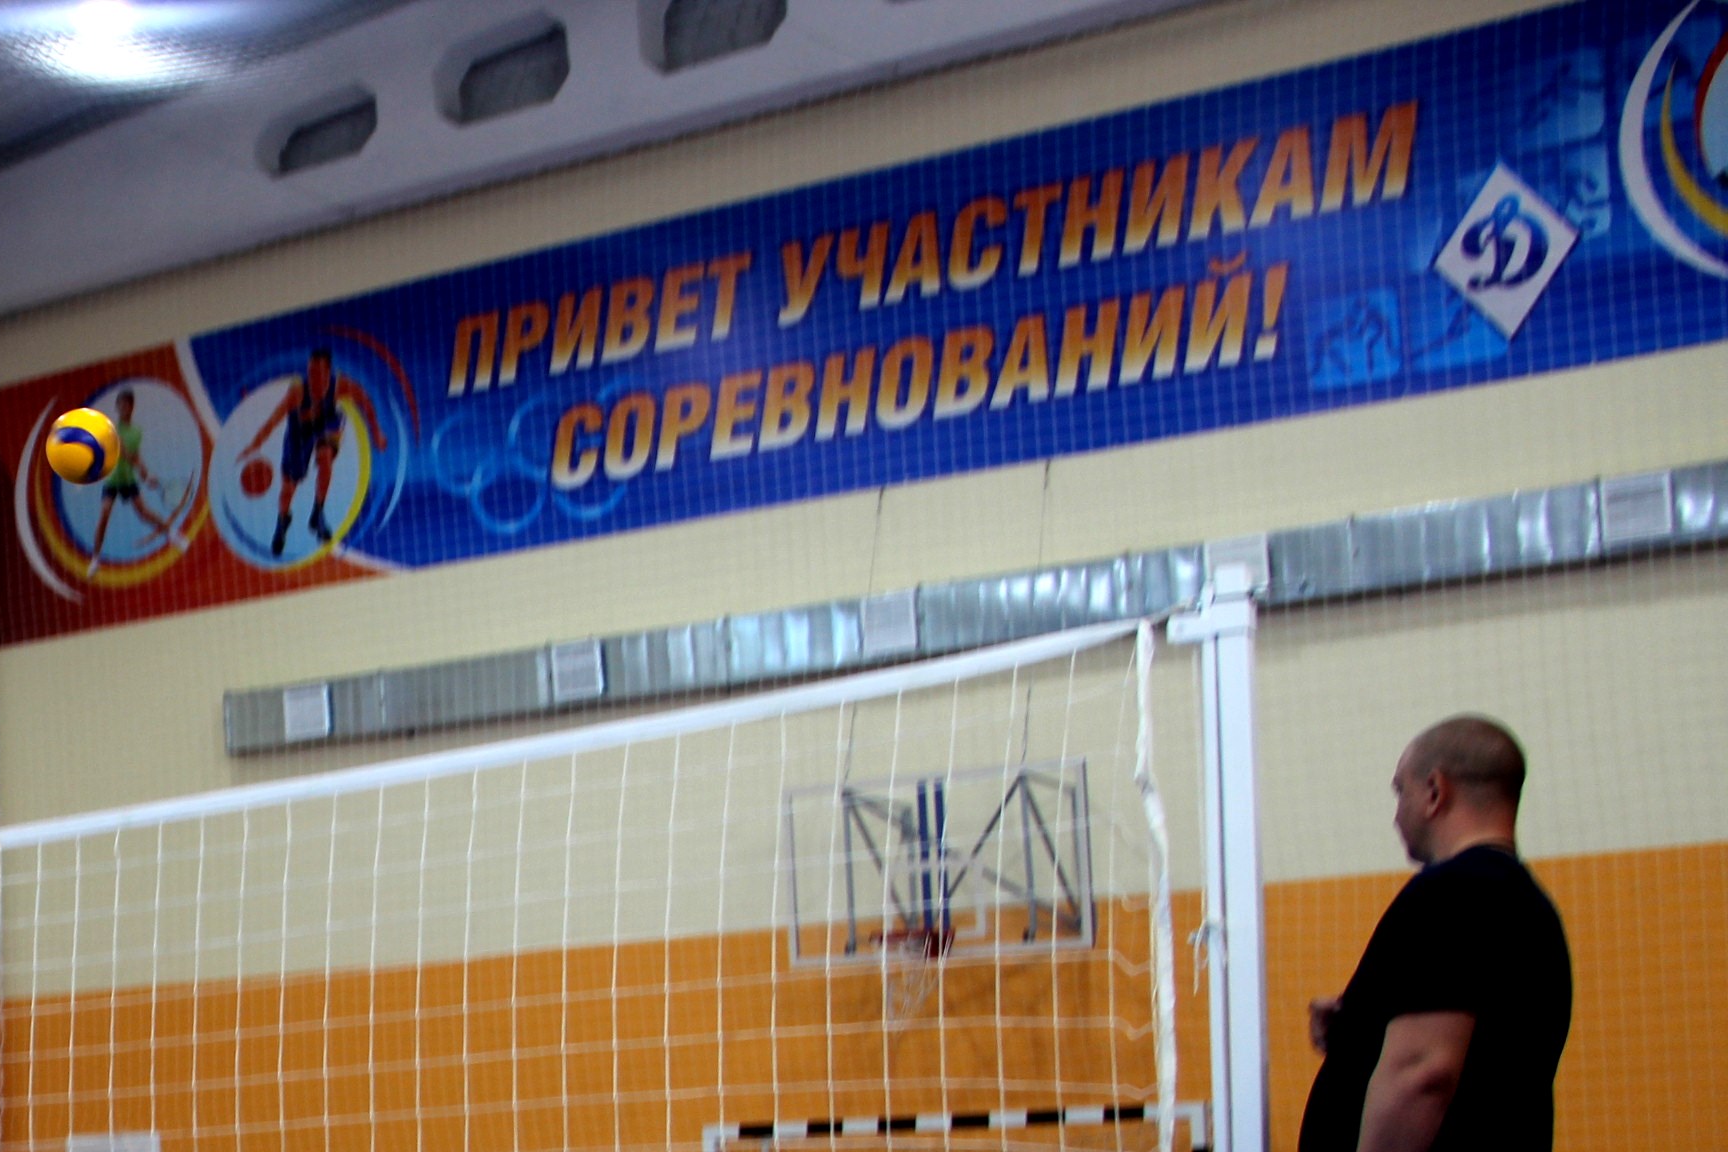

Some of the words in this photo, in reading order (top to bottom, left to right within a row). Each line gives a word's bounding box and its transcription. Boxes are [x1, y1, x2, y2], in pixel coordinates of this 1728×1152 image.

[448, 251, 752, 397] ПРИВЕТ
[778, 100, 1419, 329] УЧАСТНИКАМ
[551, 251, 1289, 491] СОРЕВНОВАНИЙ!
